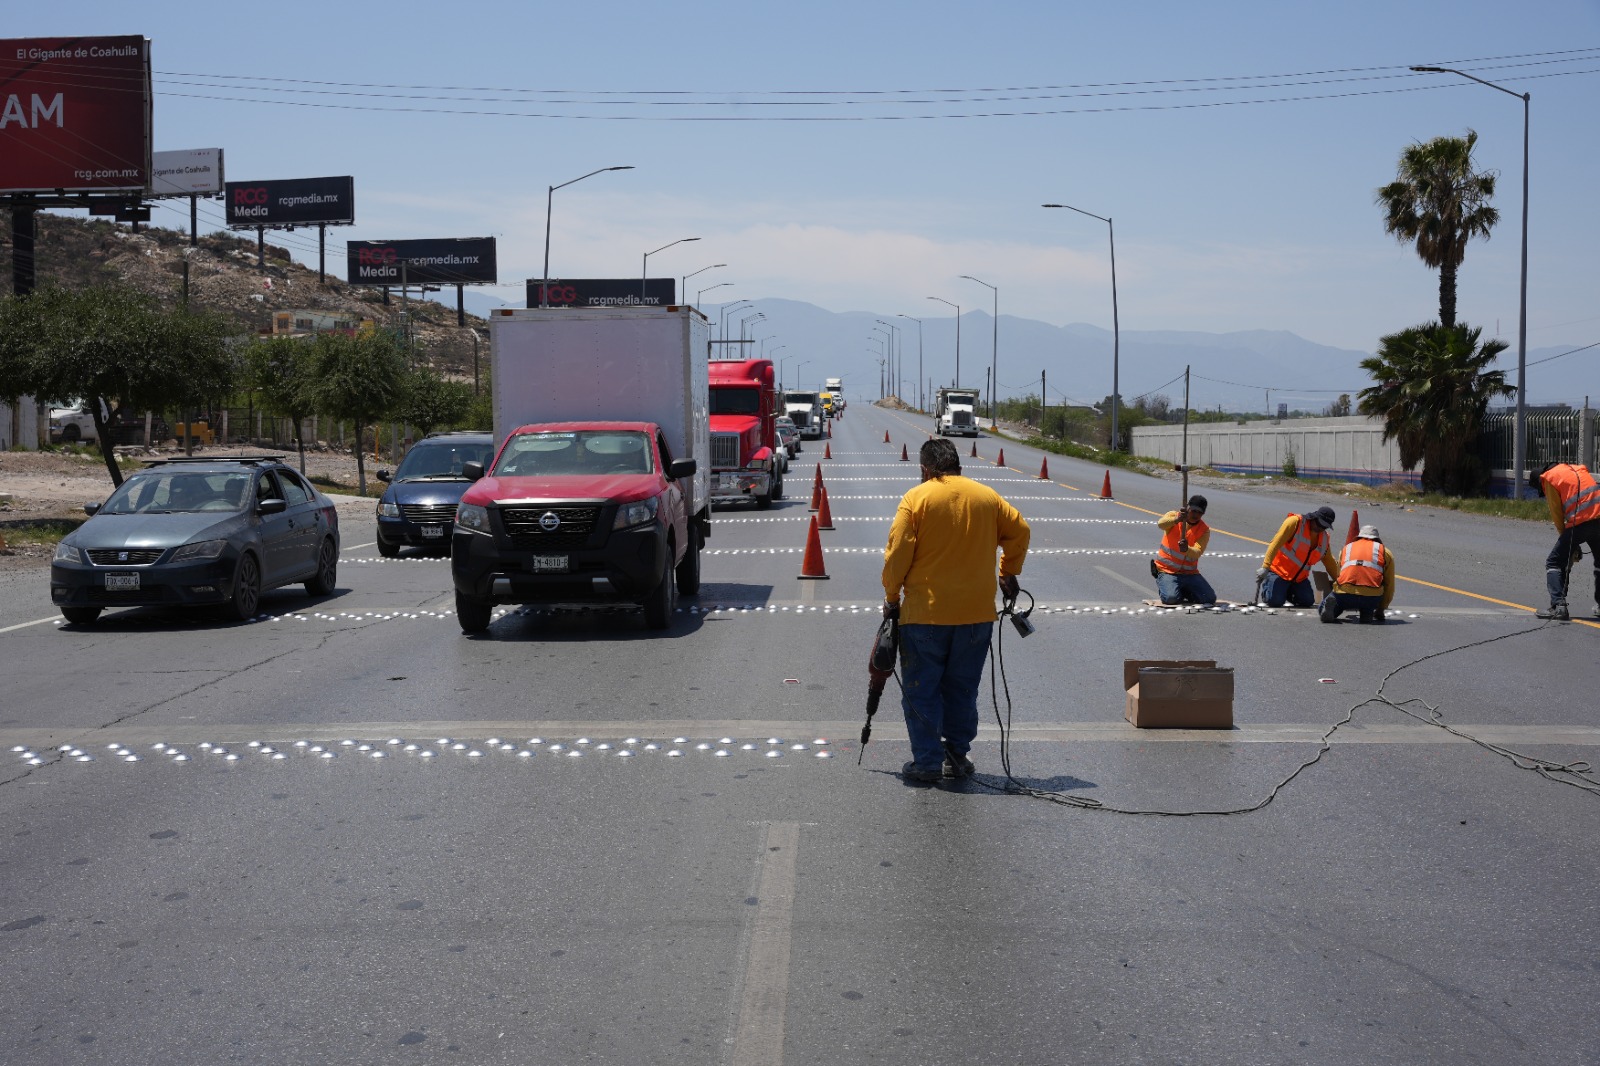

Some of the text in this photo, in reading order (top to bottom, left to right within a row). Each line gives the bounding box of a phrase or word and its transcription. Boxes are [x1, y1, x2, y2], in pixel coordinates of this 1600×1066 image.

[17, 45, 138, 61] El Gigante de Coahuila
[0, 92, 64, 128] AM
[74, 169, 138, 180] rcg.com.mx
[234, 188, 268, 205] RCG
[278, 194, 338, 207] rcgmedia.mx
[234, 206, 268, 217] Media
[359, 247, 398, 265] RCG
[359, 265, 397, 277] Media
